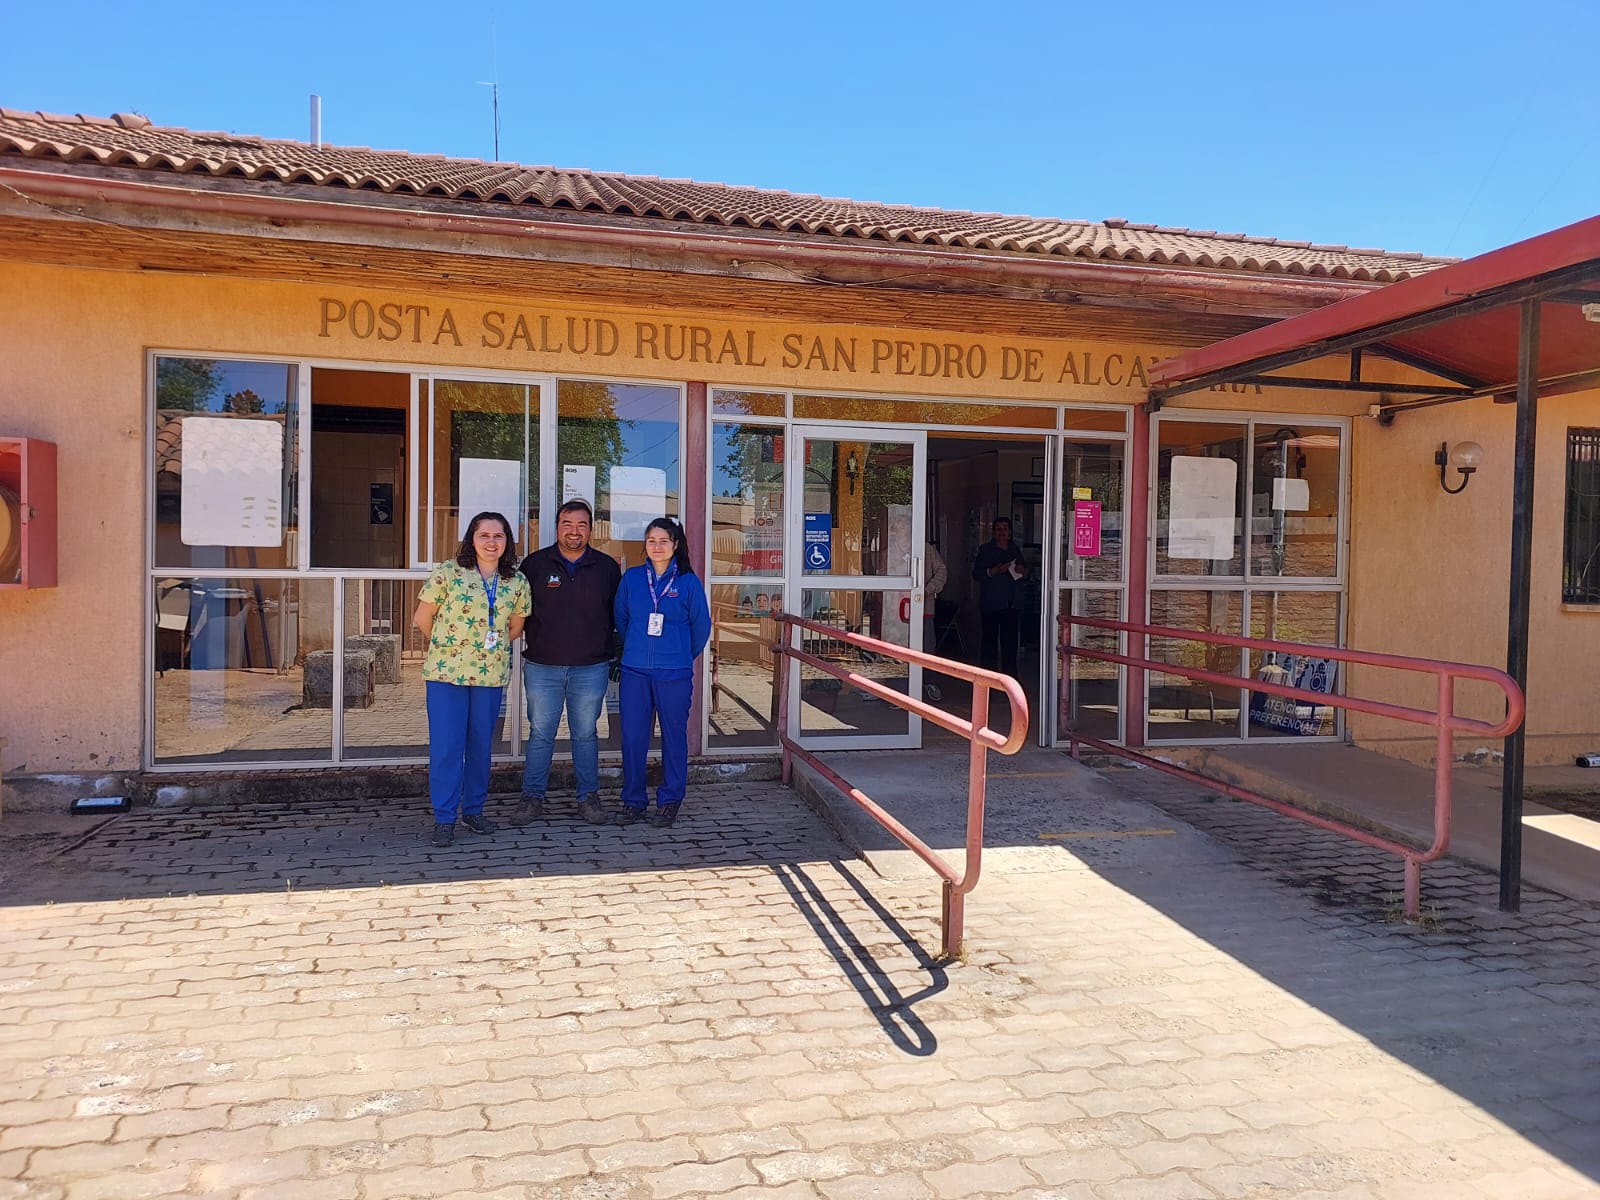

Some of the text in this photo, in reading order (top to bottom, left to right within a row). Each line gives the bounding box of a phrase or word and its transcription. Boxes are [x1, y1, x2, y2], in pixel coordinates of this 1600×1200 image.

[318, 298, 463, 347] POSTA
[481, 310, 619, 357] SALUD
[634, 321, 767, 367] RURAL
[782, 333, 856, 373] SAN
[870, 339, 987, 379] PEDRO
[1000, 346, 1044, 383] DE
[1250, 709, 1315, 734] PREFERENCIAL
